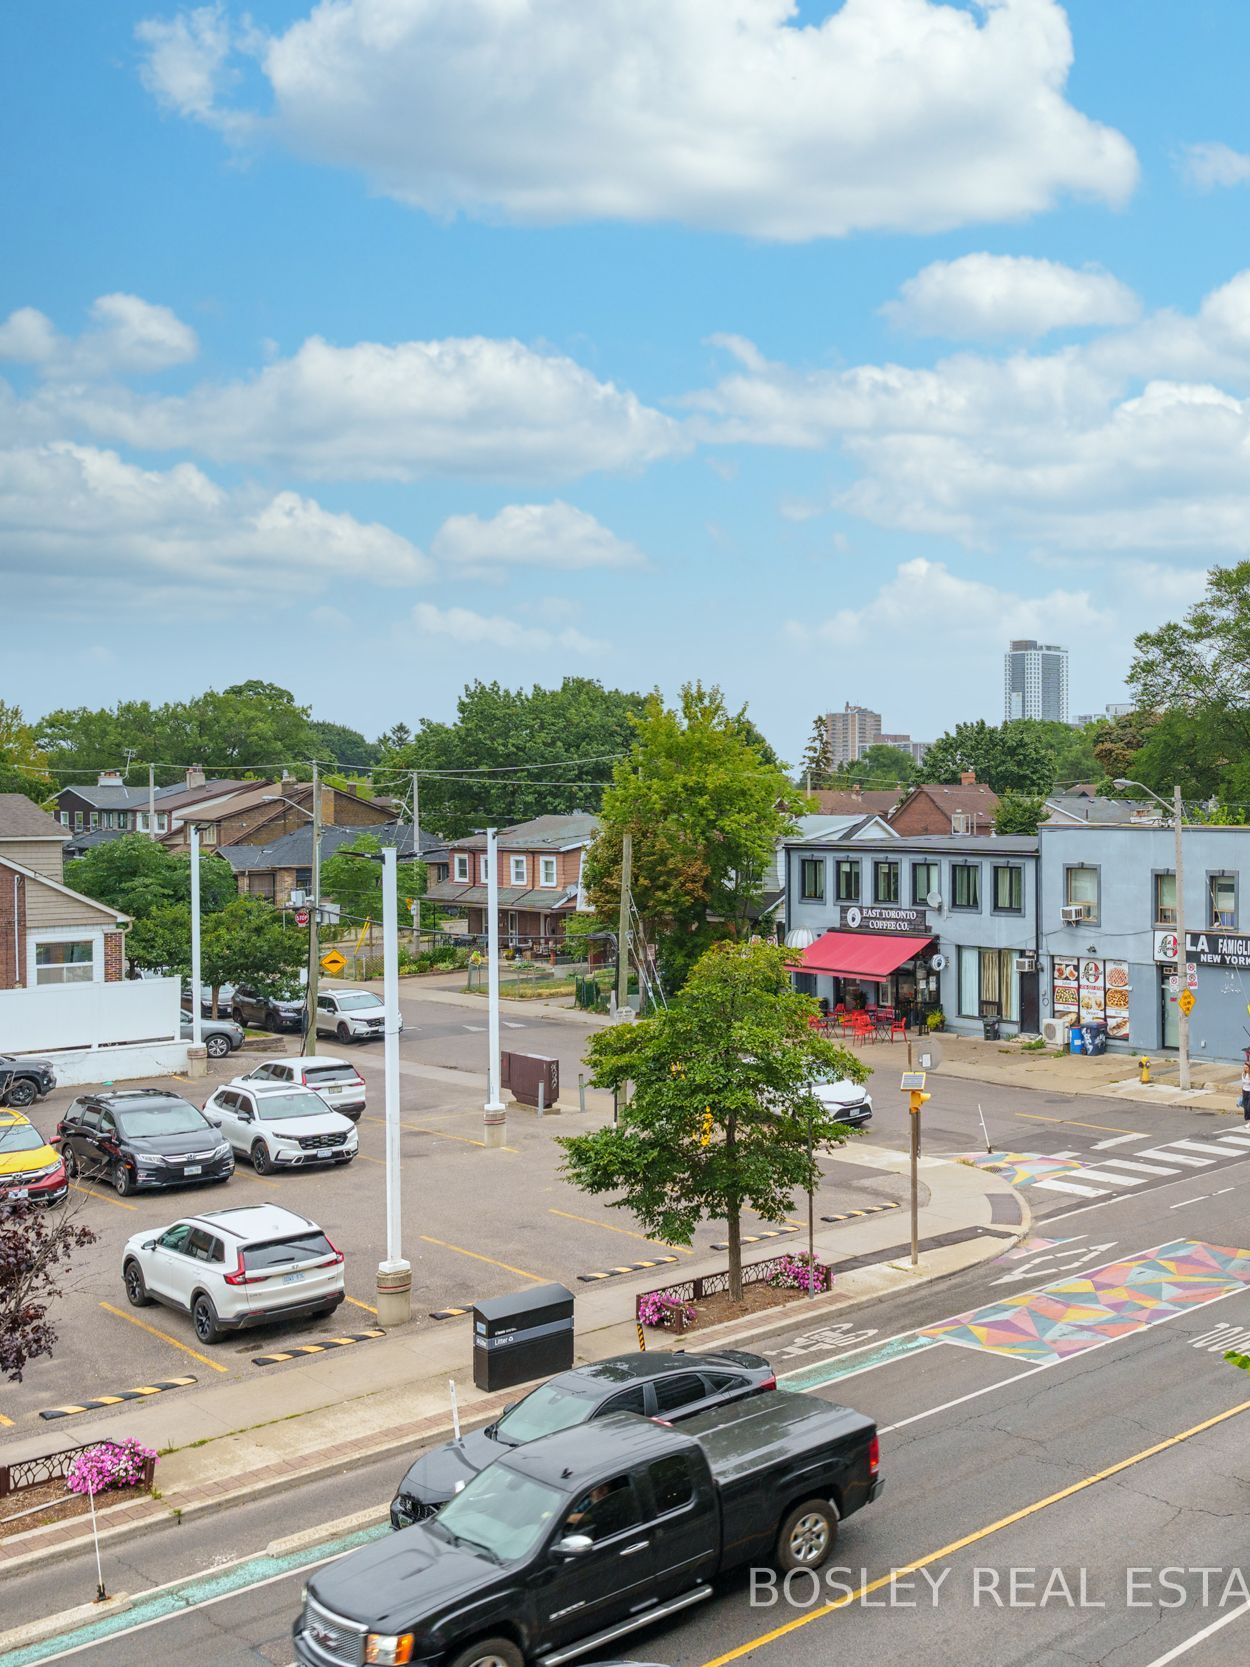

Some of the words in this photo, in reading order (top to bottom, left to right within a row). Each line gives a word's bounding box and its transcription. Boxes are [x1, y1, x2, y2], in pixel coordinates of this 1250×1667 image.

[863, 908, 880, 918] EAST
[881, 909, 917, 920] TORONTO
[869, 920, 897, 930] COFFEE
[897, 921, 910, 931] CO.
[1186, 934, 1209, 952] LA
[1200, 954, 1222, 964] NEW
[494, 1336, 509, 1346] Litter
